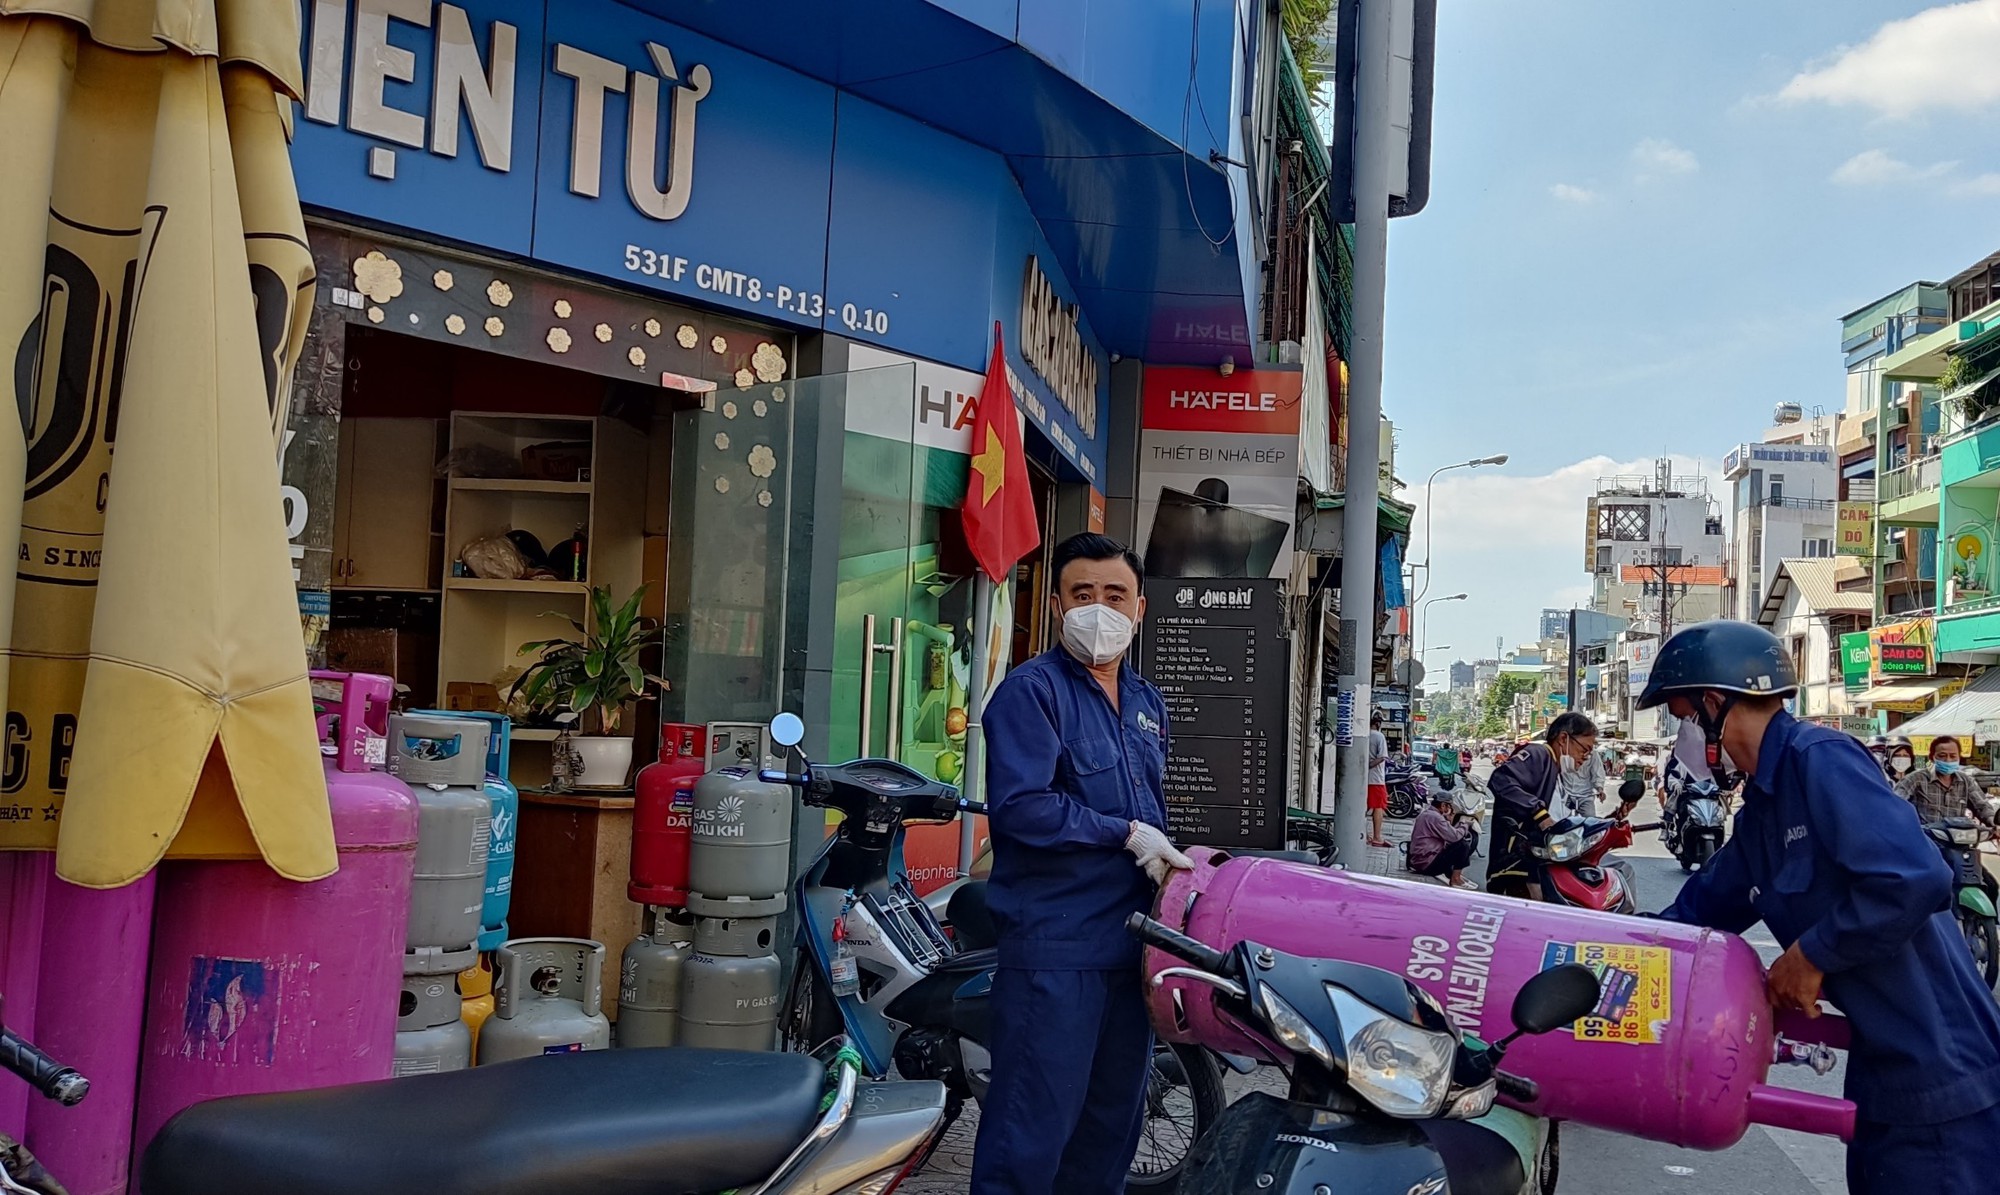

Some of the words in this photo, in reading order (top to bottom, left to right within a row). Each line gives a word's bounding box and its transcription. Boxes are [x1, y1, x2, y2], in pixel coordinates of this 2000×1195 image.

[553, 40, 712, 222] TỪ
[624, 244, 688, 281] 531F
[695, 263, 763, 302] CMT8
[777, 286, 823, 318] P.13
[842, 303, 888, 335] Q.10
[1170, 390, 1276, 411] HÄFELE
[1153, 444, 1195, 461] THIẾT
[1199, 448, 1213, 464] BỊ
[1218, 447, 1250, 462] NHÀ
[1255, 448, 1286, 464] BẾP
[353, 727, 367, 756] 37.7
[693, 808, 716, 821] GAS
[716, 822, 746, 837] KHÍ
[1406, 935, 1450, 982] GAS
[736, 999, 749, 1009] PV
[752, 997, 768, 1008] GAS
[1650, 976, 1661, 1010] 739
[1274, 1133, 1339, 1153] HONDA
